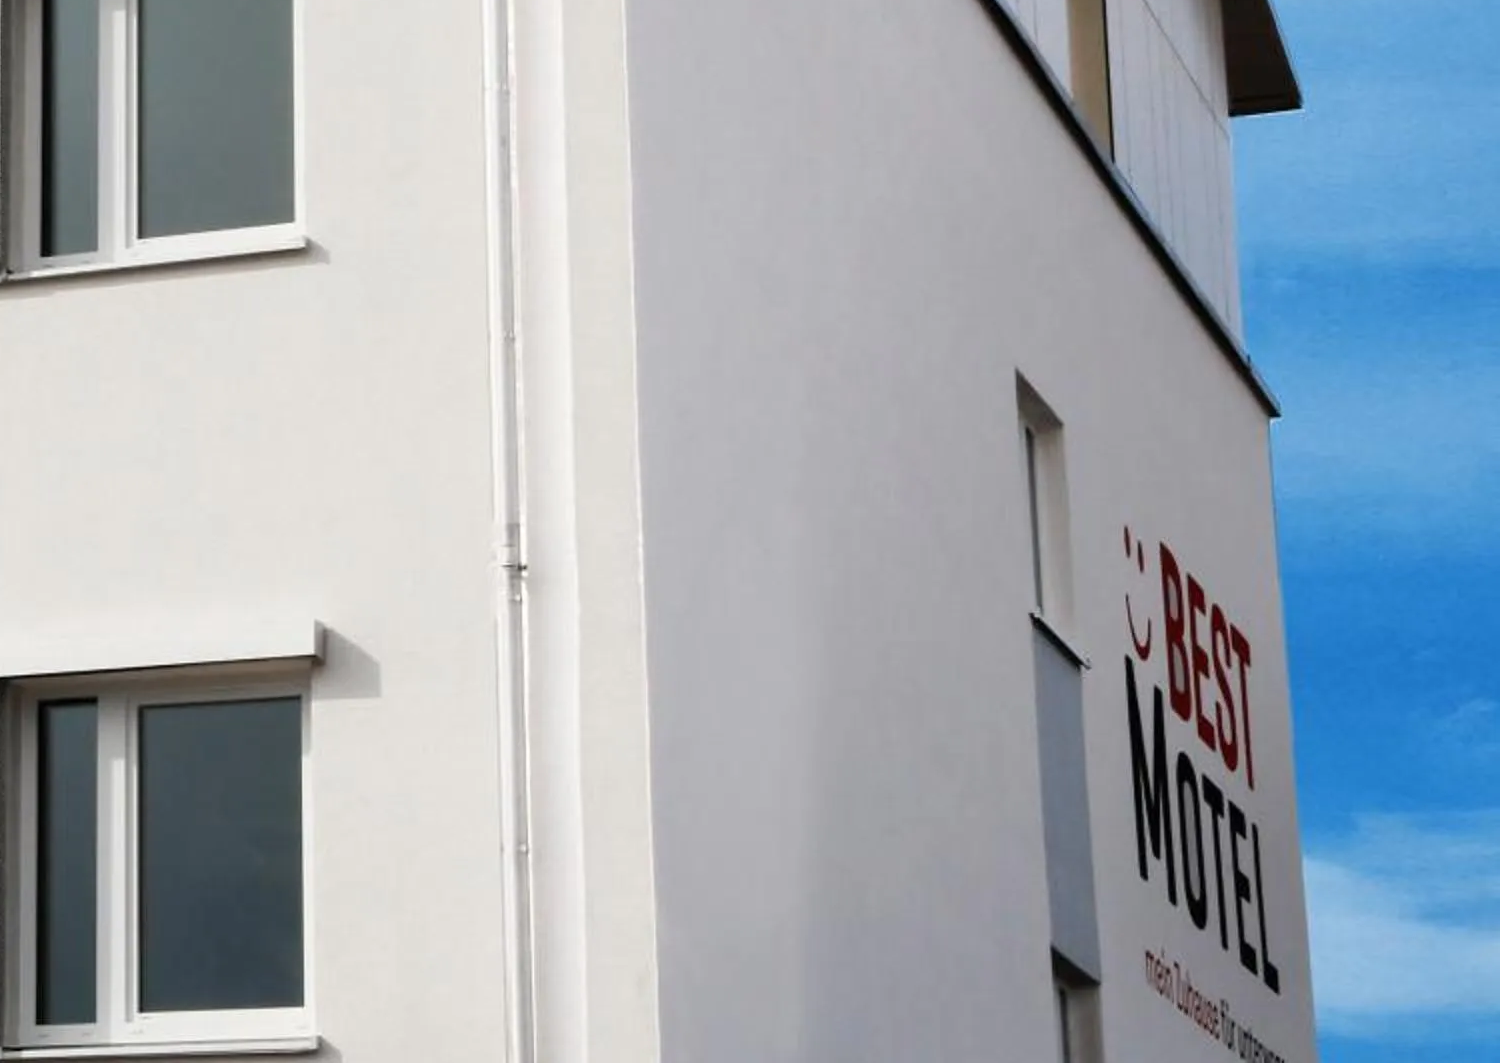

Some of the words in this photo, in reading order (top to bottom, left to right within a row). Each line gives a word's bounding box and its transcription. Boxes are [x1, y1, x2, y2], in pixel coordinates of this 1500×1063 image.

[1159, 541, 1255, 791] BEST
[1124, 654, 1282, 997] MOTEL
[1144, 946, 1174, 1003] mein
